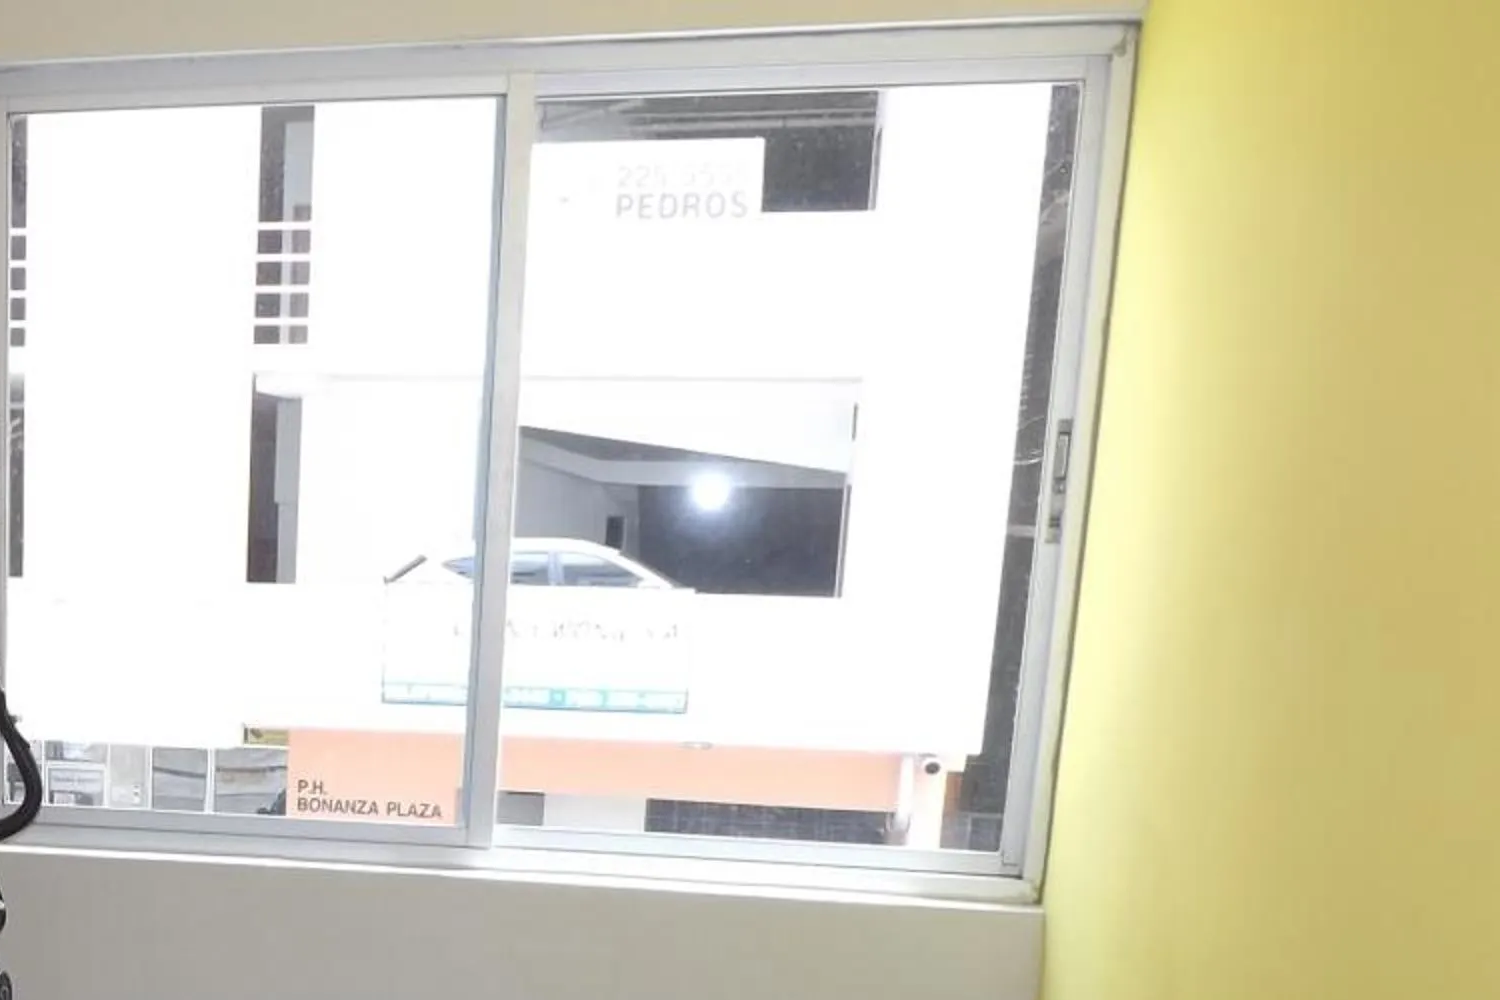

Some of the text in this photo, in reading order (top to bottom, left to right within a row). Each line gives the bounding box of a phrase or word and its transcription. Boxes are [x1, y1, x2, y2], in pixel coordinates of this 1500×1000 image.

[615, 190, 749, 219] PEDROS
[297, 779, 327, 795] P.H.
[297, 797, 443, 819] BONANZA PLAZA
